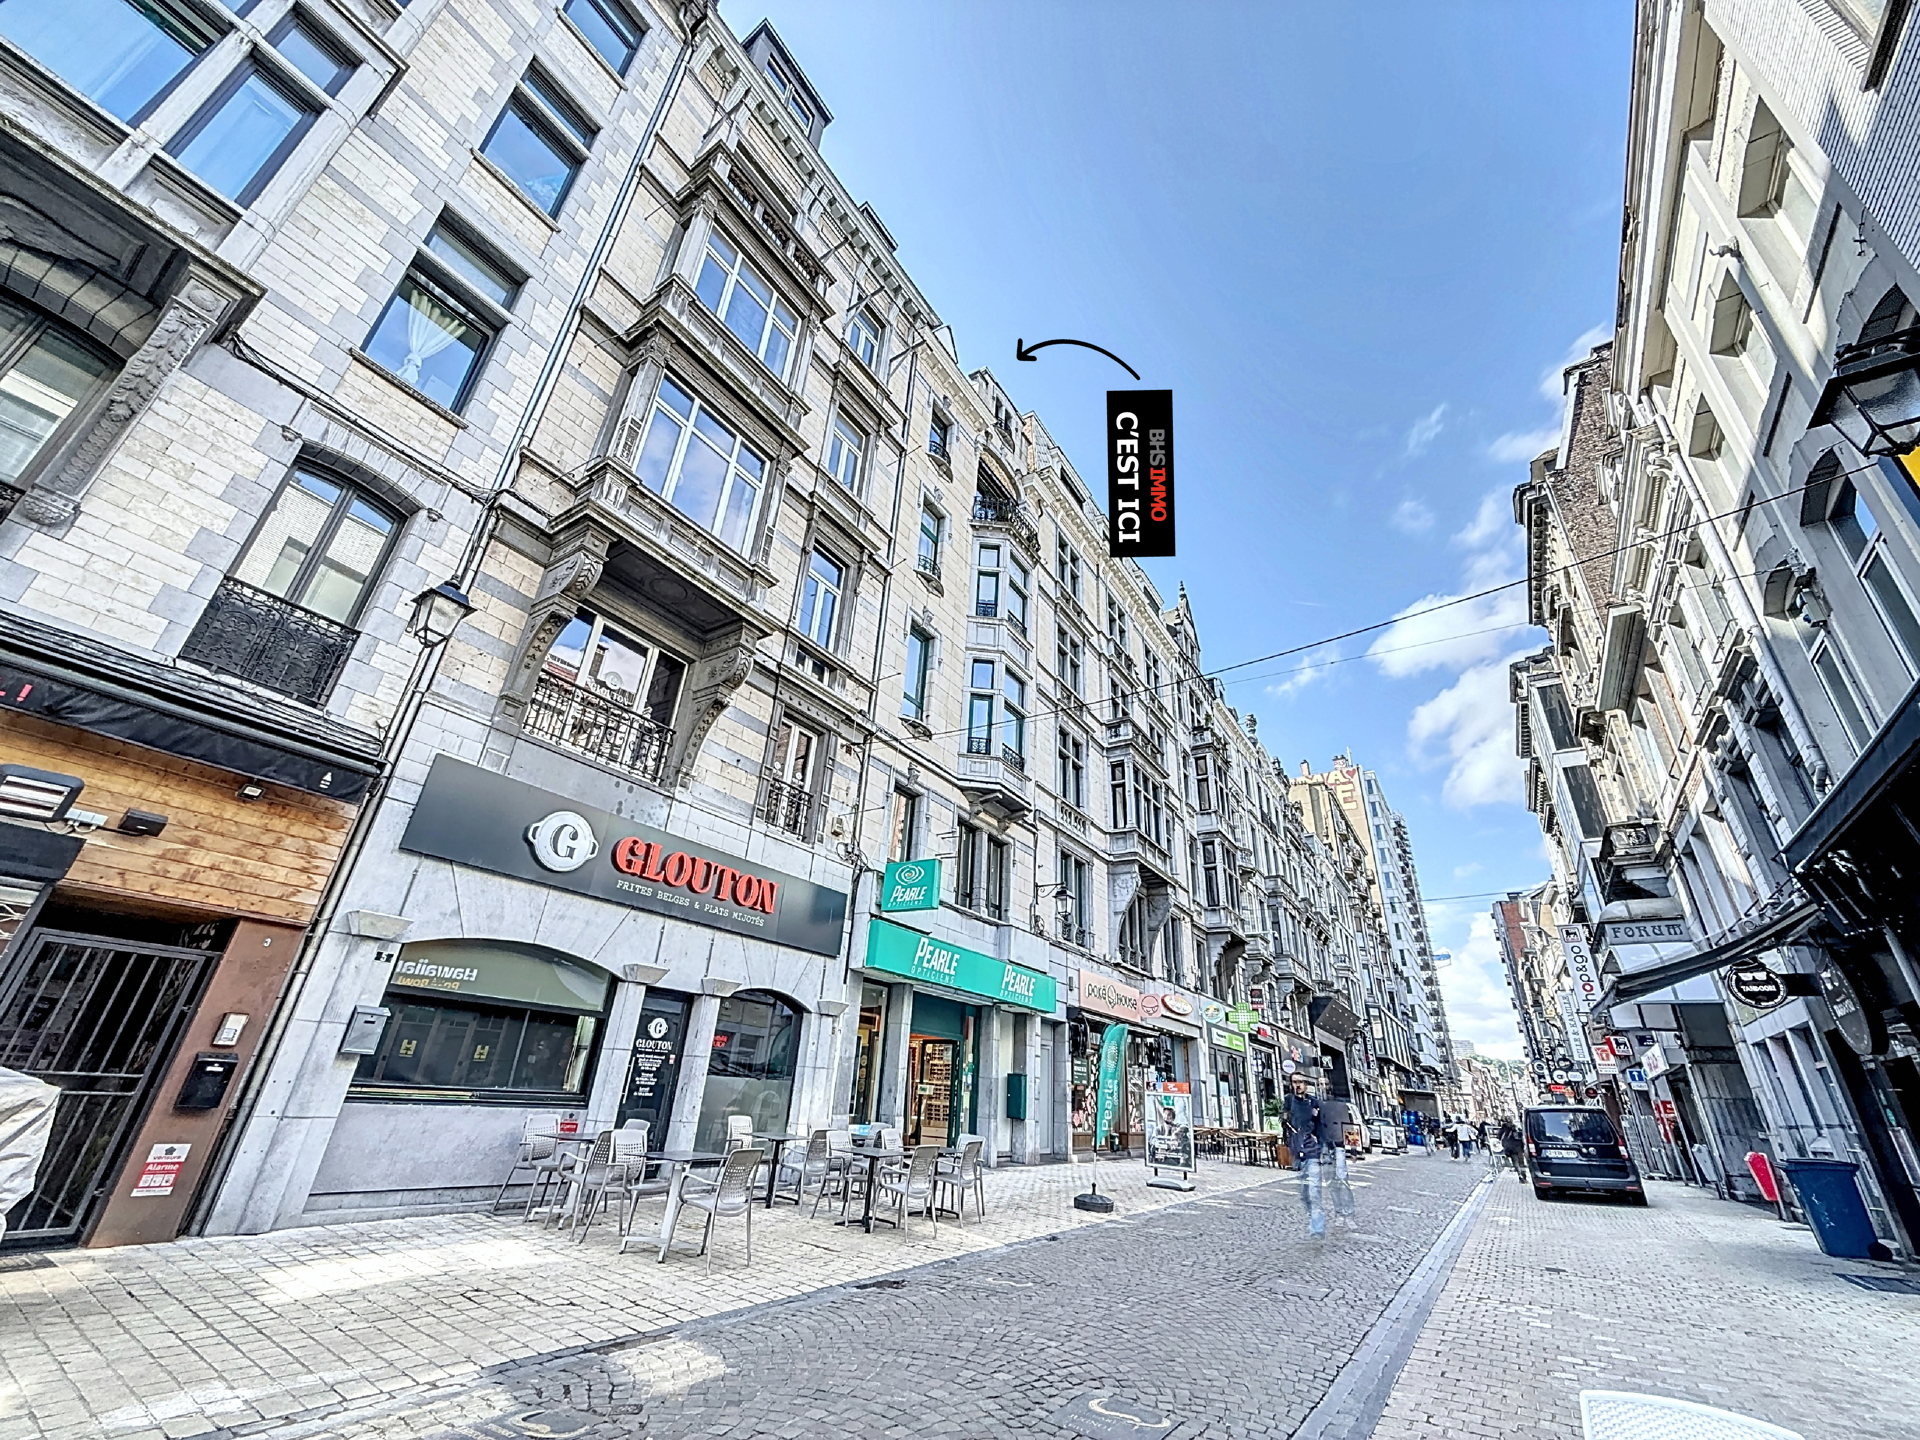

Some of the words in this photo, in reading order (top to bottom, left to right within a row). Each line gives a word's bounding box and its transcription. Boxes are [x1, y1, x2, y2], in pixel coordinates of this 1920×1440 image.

[611, 836, 780, 915] GLOUTON
[890, 885, 927, 902] PEARLE
[616, 879, 653, 897] FRITES
[656, 890, 691, 907] BELGES
[694, 900, 700, 909] &
[704, 903, 729, 917] PLATS
[732, 911, 765, 927] MIJOTÉS
[888, 899, 923, 908] OPTICIENS
[1611, 923, 1684, 938] FORUM
[913, 936, 960, 976] PEARLE
[910, 965, 955, 985] OPTICIENS
[1002, 965, 1036, 996] PEARLE
[999, 989, 1033, 1005] OPTICIENS
[636, 1038, 673, 1050] GLOUTON
[1102, 1078, 1113, 1131] Pearle
[146, 1163, 180, 1171] Alarme
